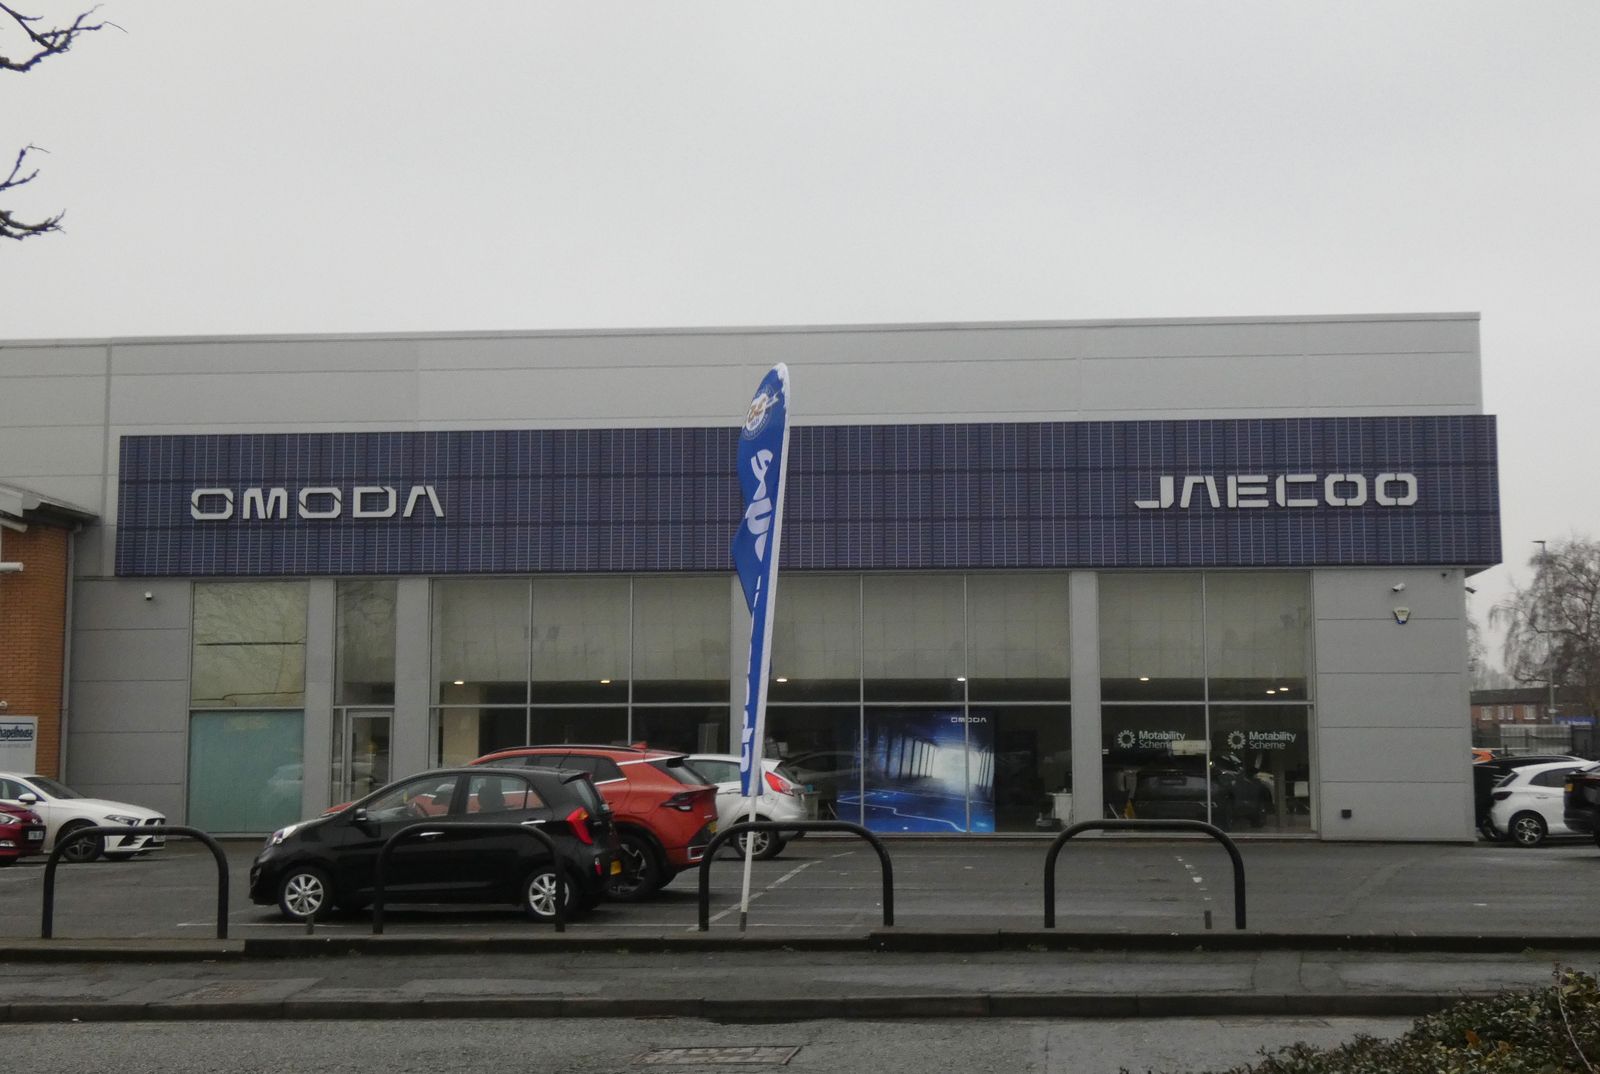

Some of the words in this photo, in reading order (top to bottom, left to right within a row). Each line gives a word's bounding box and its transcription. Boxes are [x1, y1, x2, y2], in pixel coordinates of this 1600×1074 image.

[1134, 472, 1418, 509] JAECOO
[190, 485, 445, 521] OMODA
[0, 725, 33, 740] hapelhouse
[1138, 730, 1186, 741] Motability
[1249, 731, 1297, 743] Motability
[1249, 741, 1286, 750] Scheme
